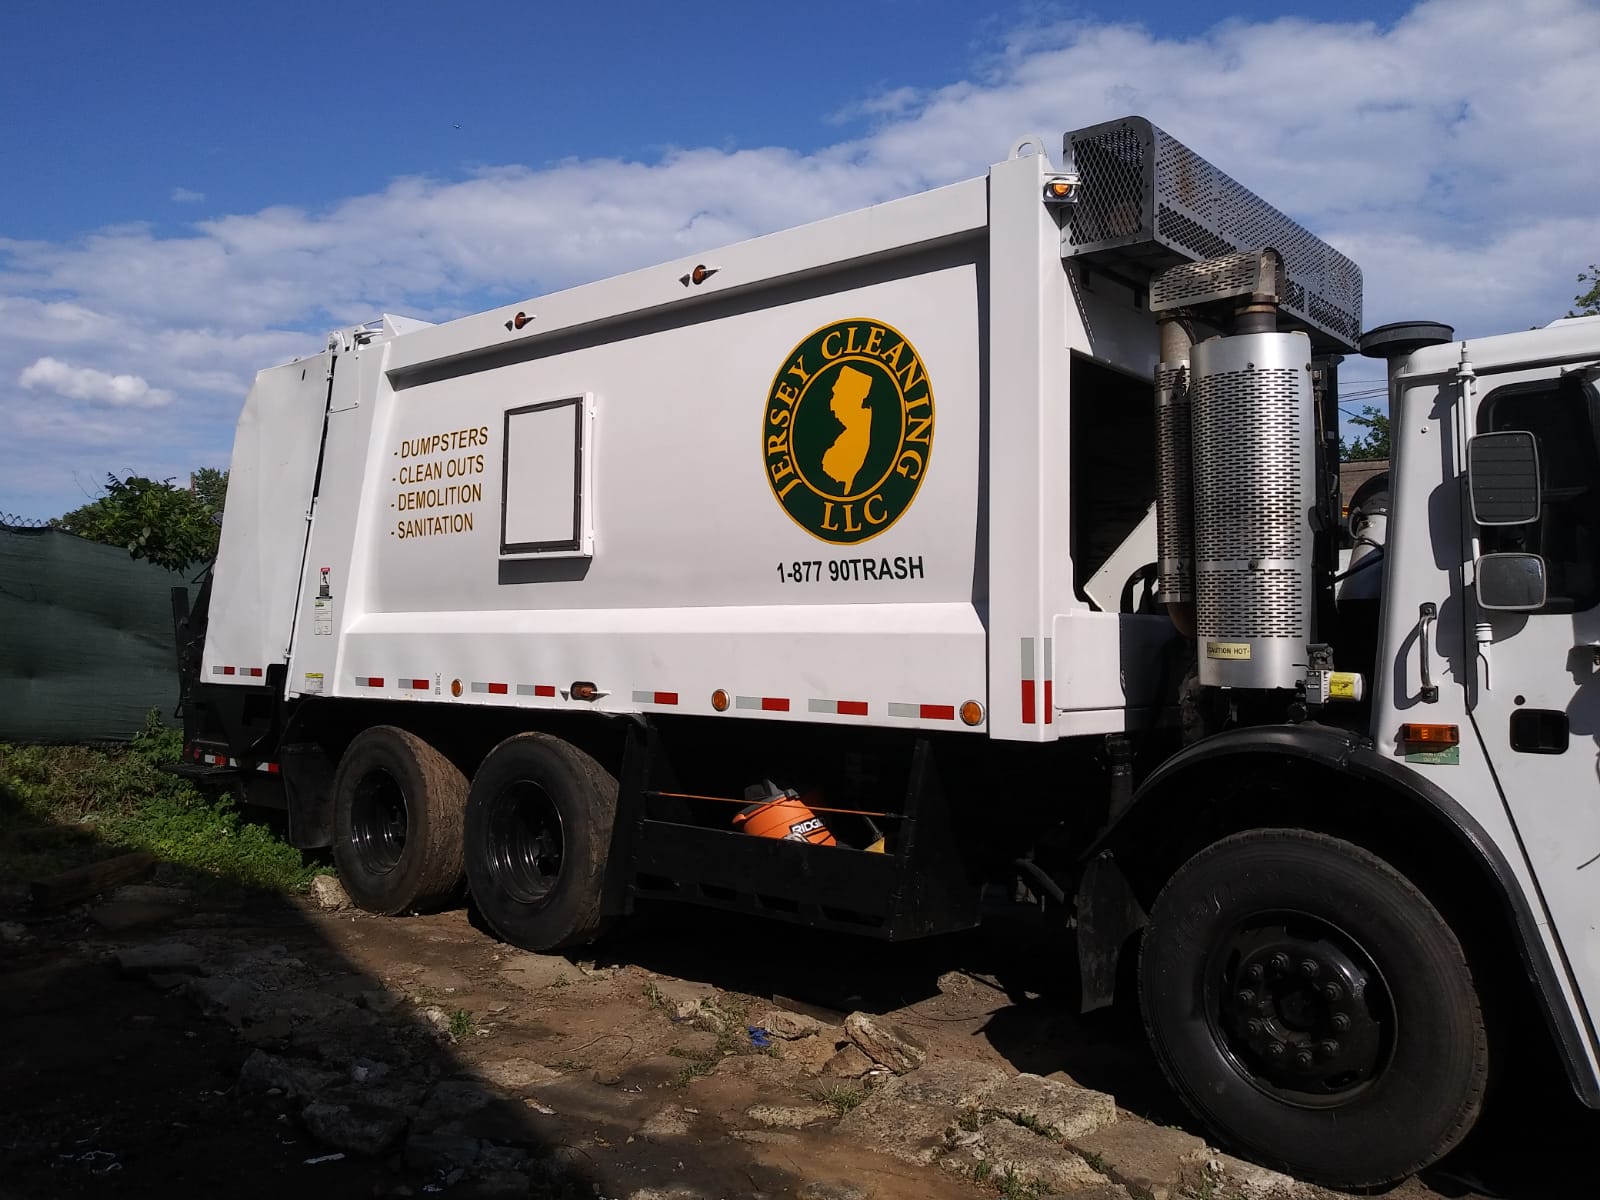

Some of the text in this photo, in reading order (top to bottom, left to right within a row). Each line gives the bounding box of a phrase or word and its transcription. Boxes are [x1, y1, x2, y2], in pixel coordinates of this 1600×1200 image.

[767, 326, 931, 501] JERSEY CLEANING
[401, 426, 489, 459] DUMPSTERS
[399, 461, 443, 485] CLEAN
[446, 454, 484, 478] OUTS
[398, 482, 482, 512] DEMOLITION
[397, 512, 474, 540] SANITATION
[820, 493, 888, 533] LLC
[776, 555, 925, 584] 1-877 90TRASH
